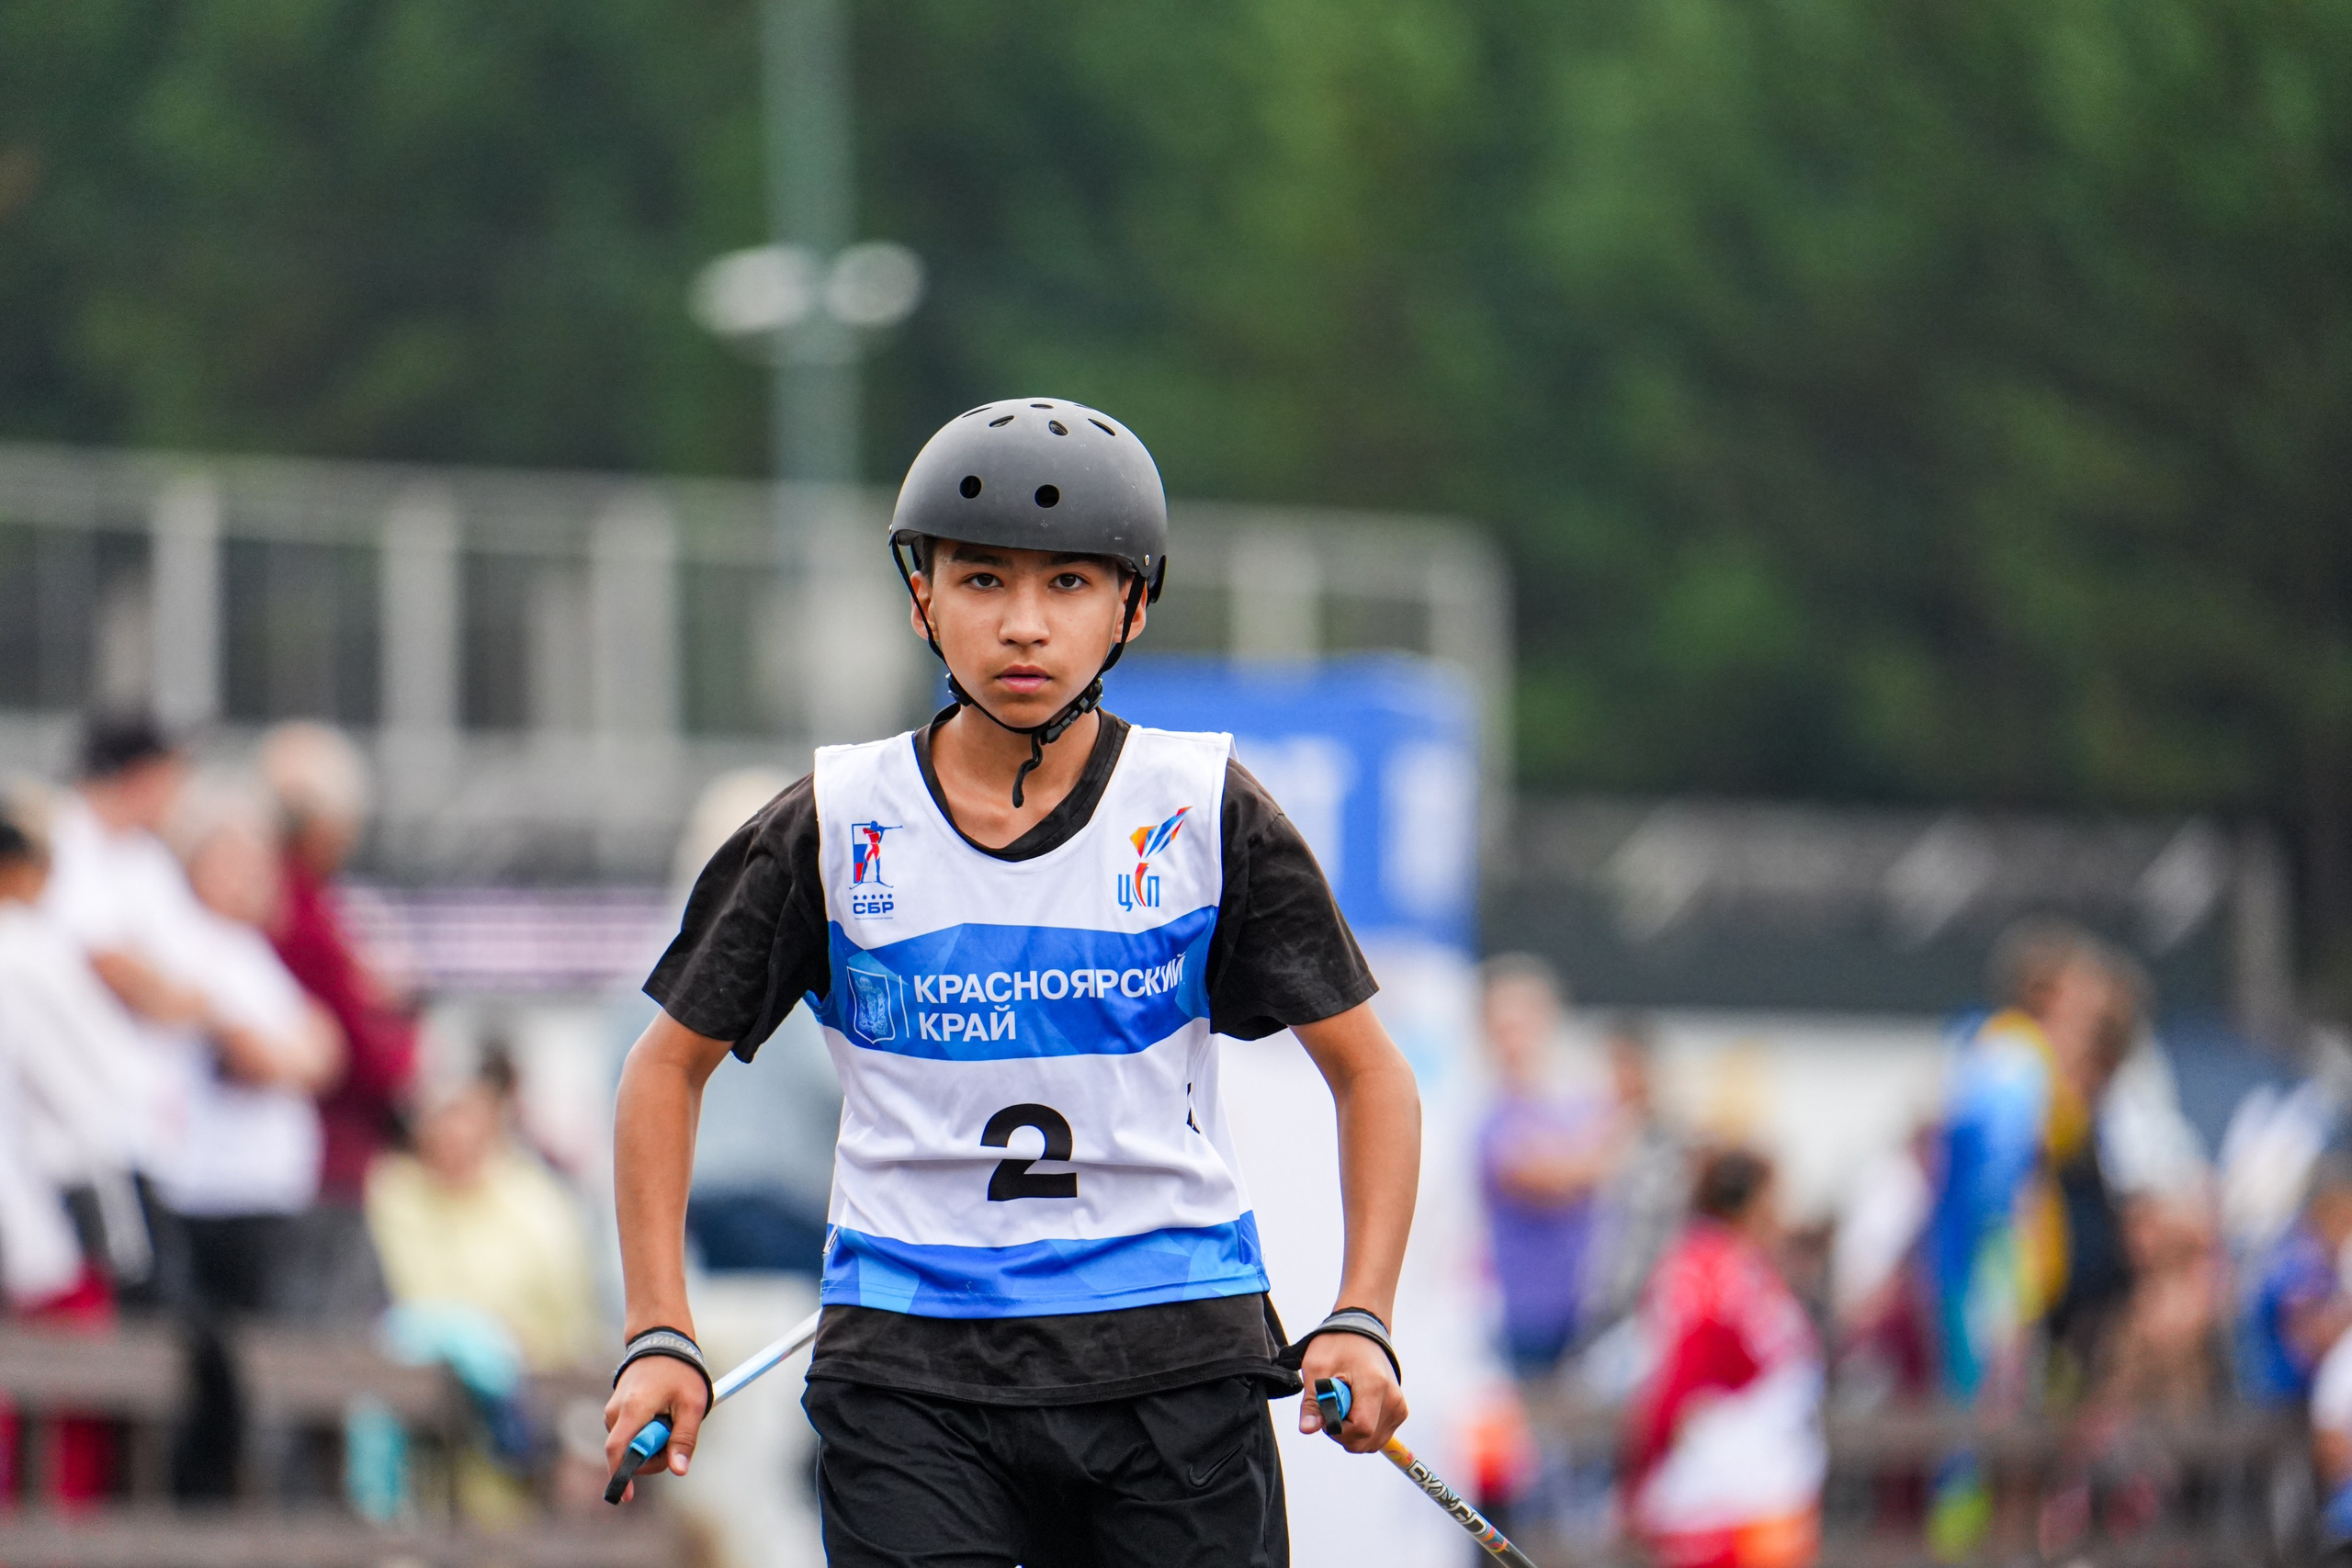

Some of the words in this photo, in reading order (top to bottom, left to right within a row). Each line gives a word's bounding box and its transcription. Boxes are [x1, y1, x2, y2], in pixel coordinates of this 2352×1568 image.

[853, 901, 894, 914] СБР
[913, 951, 1186, 1004] КРАСНОЯРСКИЙ
[919, 1004, 1016, 1042] КРАЙ
[979, 1103, 1078, 1201] 2
